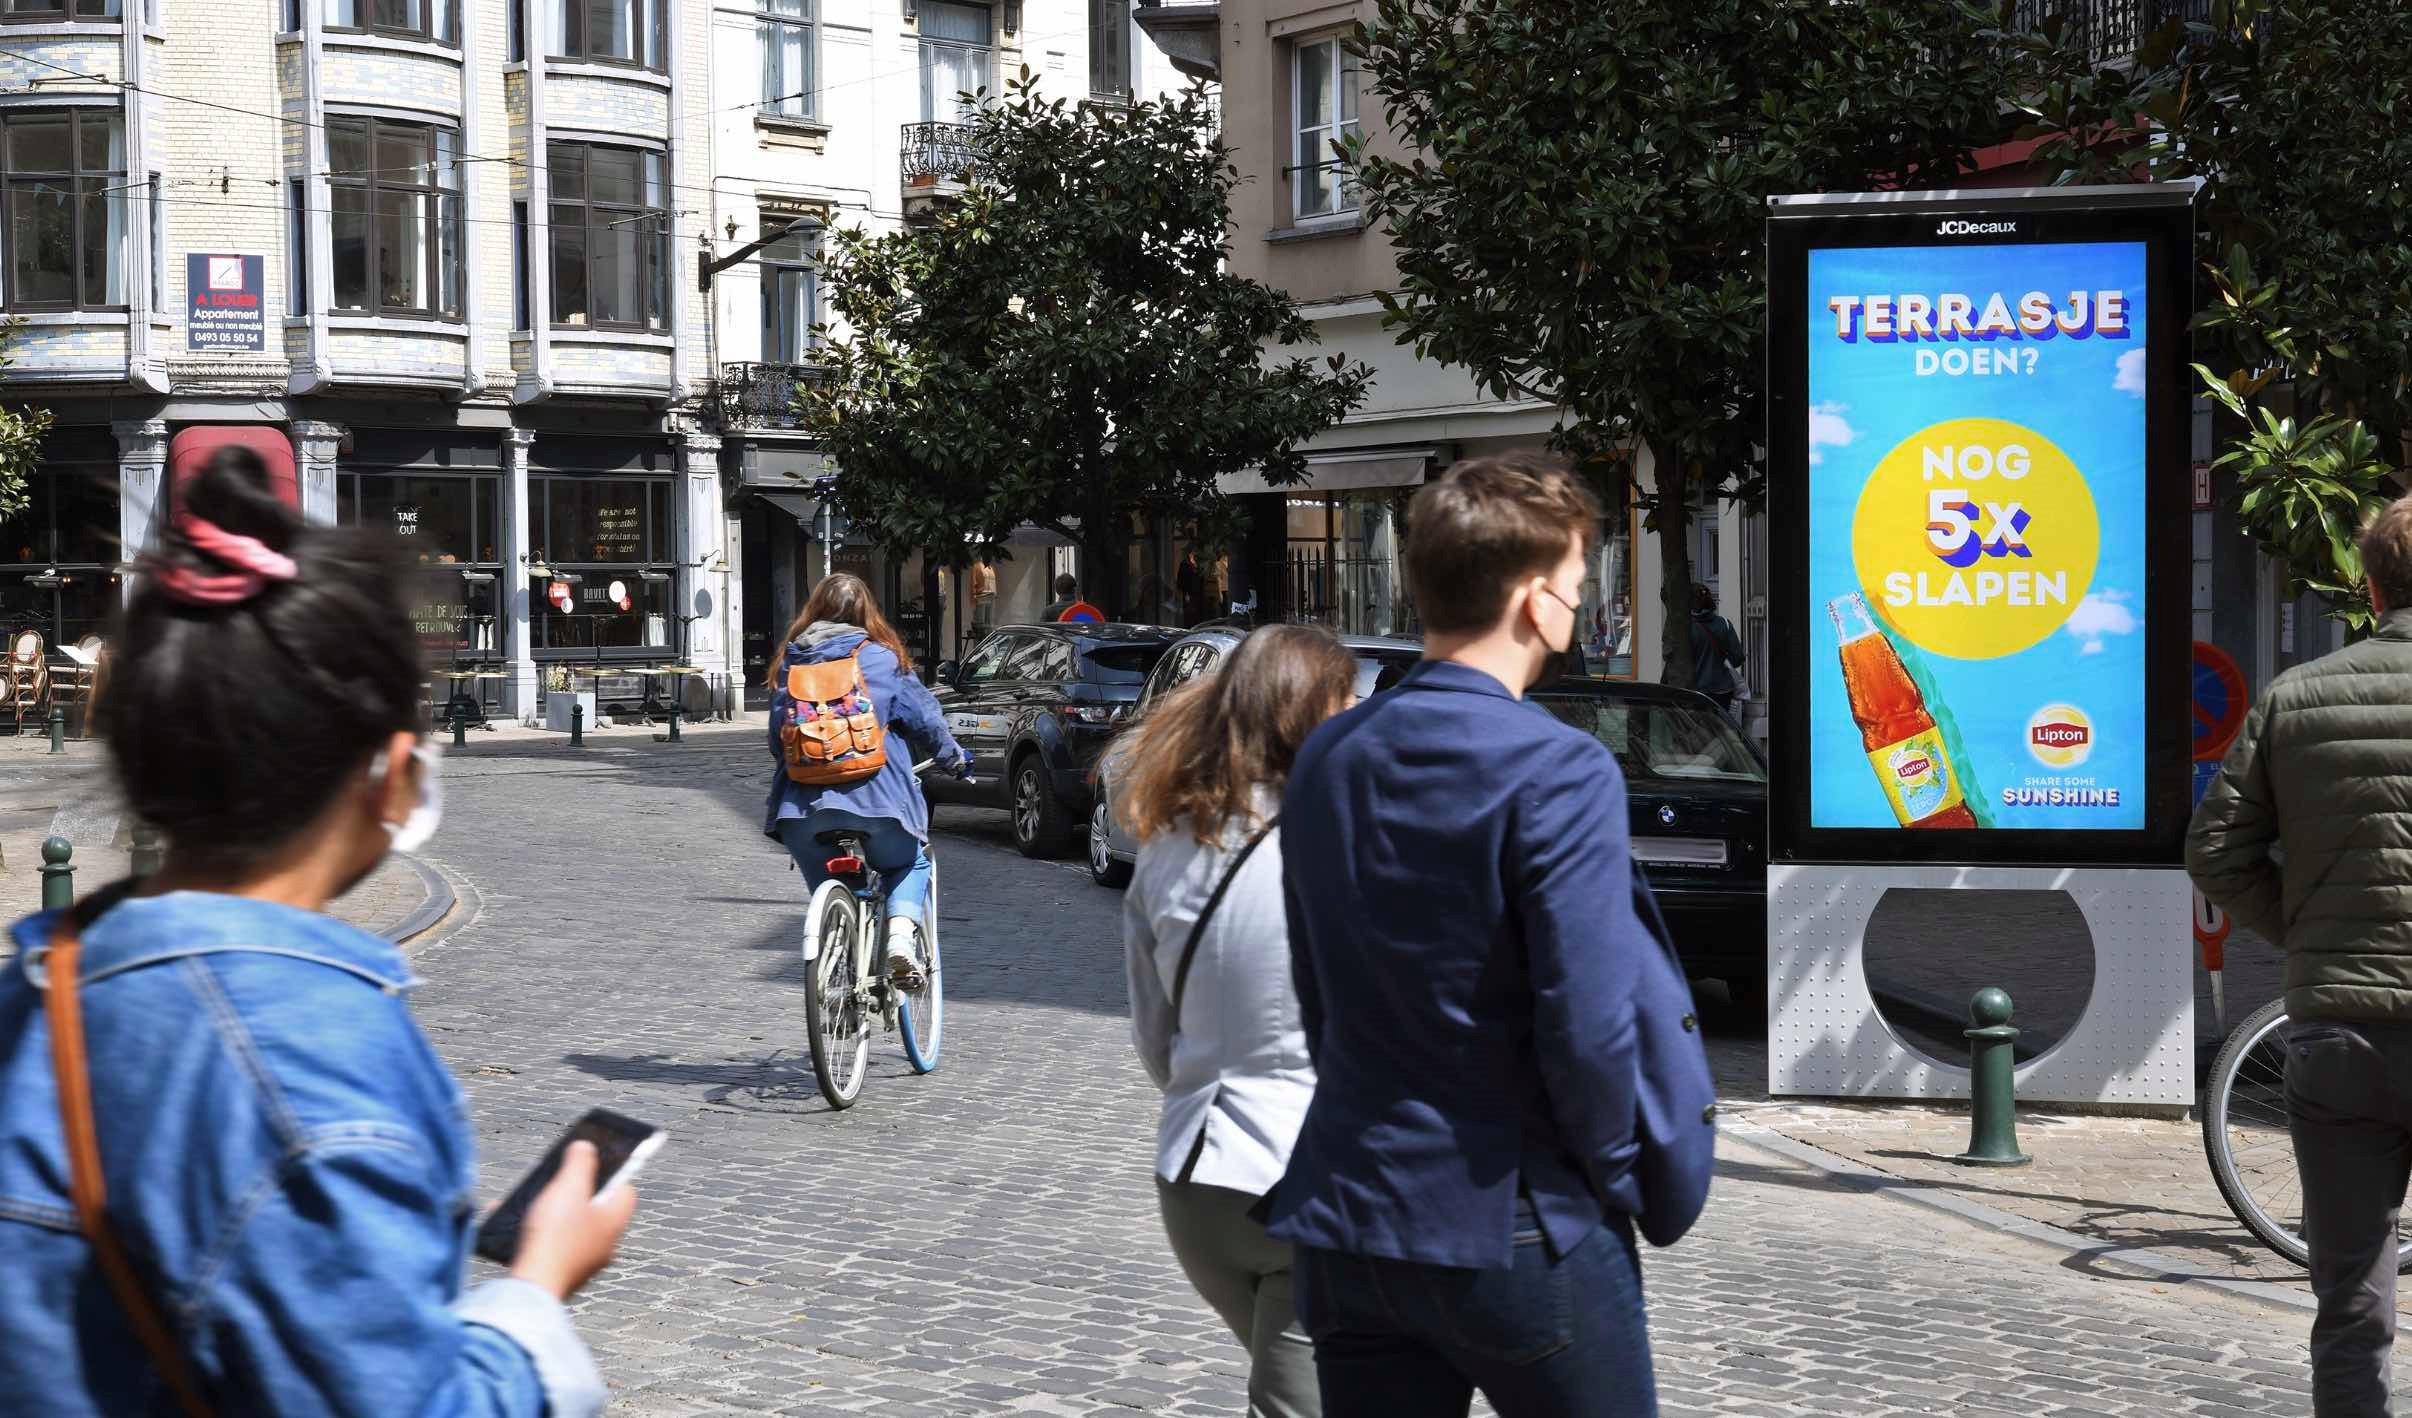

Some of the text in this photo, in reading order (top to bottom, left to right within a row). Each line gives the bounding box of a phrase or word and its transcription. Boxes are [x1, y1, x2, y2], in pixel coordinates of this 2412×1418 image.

[1936, 220, 2017, 235] JCDecaux
[195, 293, 208, 305] A
[193, 308, 259, 320] Appartement
[1830, 290, 2129, 342] TERRASJE
[194, 332, 258, 343] 0493 05 50 54
[1914, 346, 2041, 376] DOEN?
[1922, 444, 2031, 481] NOG
[397, 512, 418, 522] TAKE
[399, 525, 417, 535] OUT
[1884, 571, 2067, 606] SLAPEN
[2036, 728, 2084, 743] Lipton
[1900, 761, 1928, 776] Lipton
[2023, 776, 2097, 786] SHARE SOME
[2001, 787, 2120, 807] SUNSHINE
